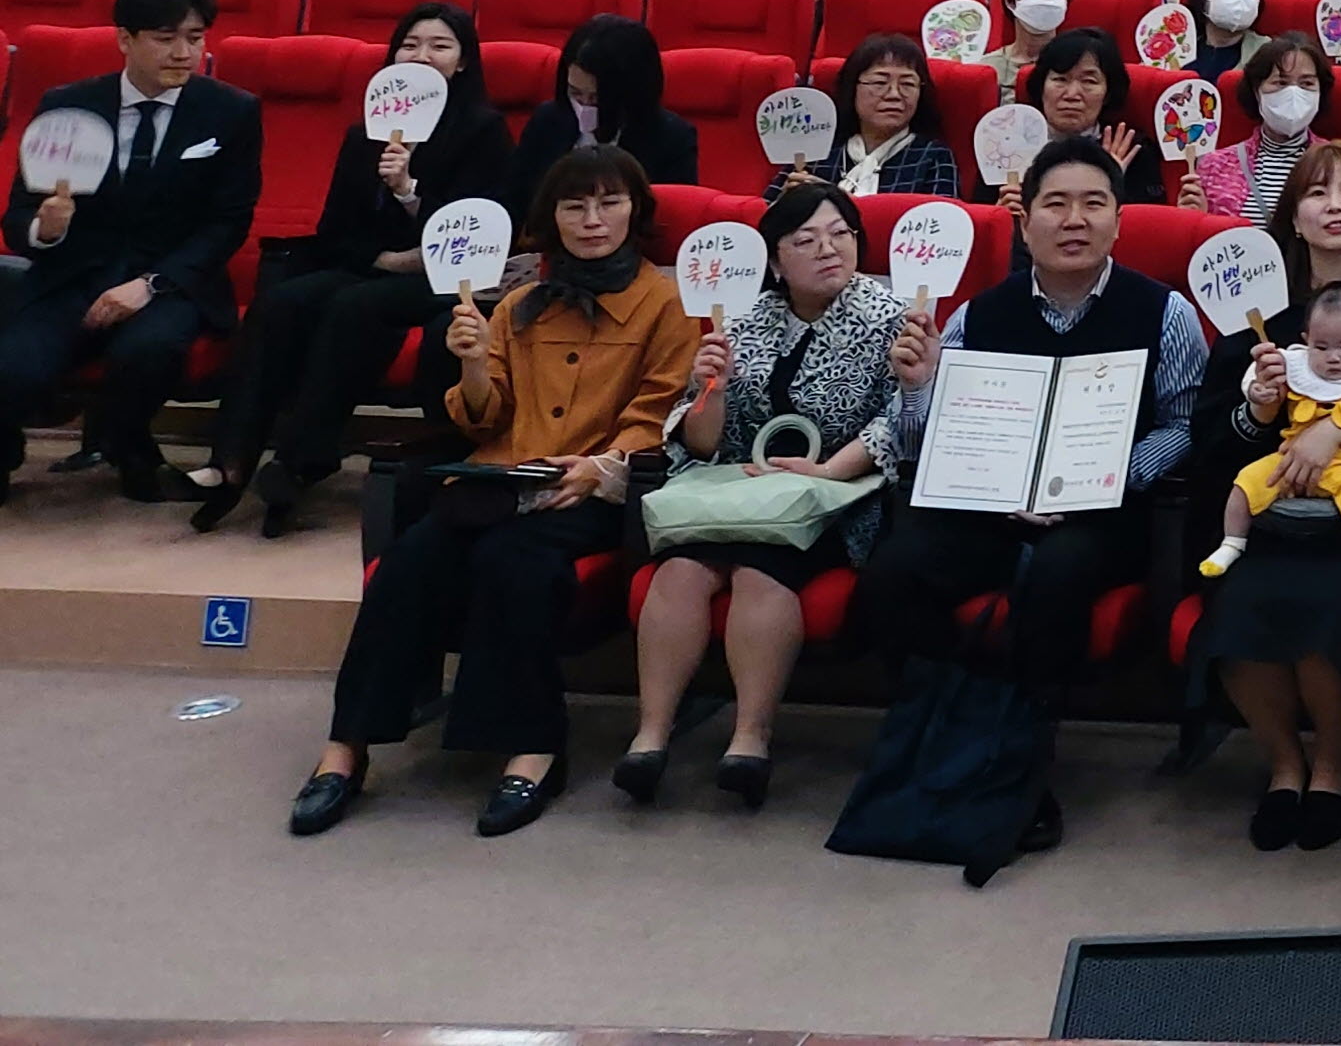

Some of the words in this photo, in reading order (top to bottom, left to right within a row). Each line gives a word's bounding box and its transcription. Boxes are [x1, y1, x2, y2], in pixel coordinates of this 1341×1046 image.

[370, 78, 408, 102] 아이는
[371, 90, 440, 117] 사랑입니다
[762, 96, 803, 114] 아이는
[437, 215, 480, 233] 아이는
[900, 219, 941, 235] 아이는
[427, 236, 501, 266] 기쁨입니다
[689, 233, 735, 254] 아이는
[894, 239, 963, 267] 사랑입니다
[1202, 243, 1246, 272] 아이는
[684, 258, 758, 291] 축복입니다
[1200, 262, 1276, 301] 기쁨입니다
